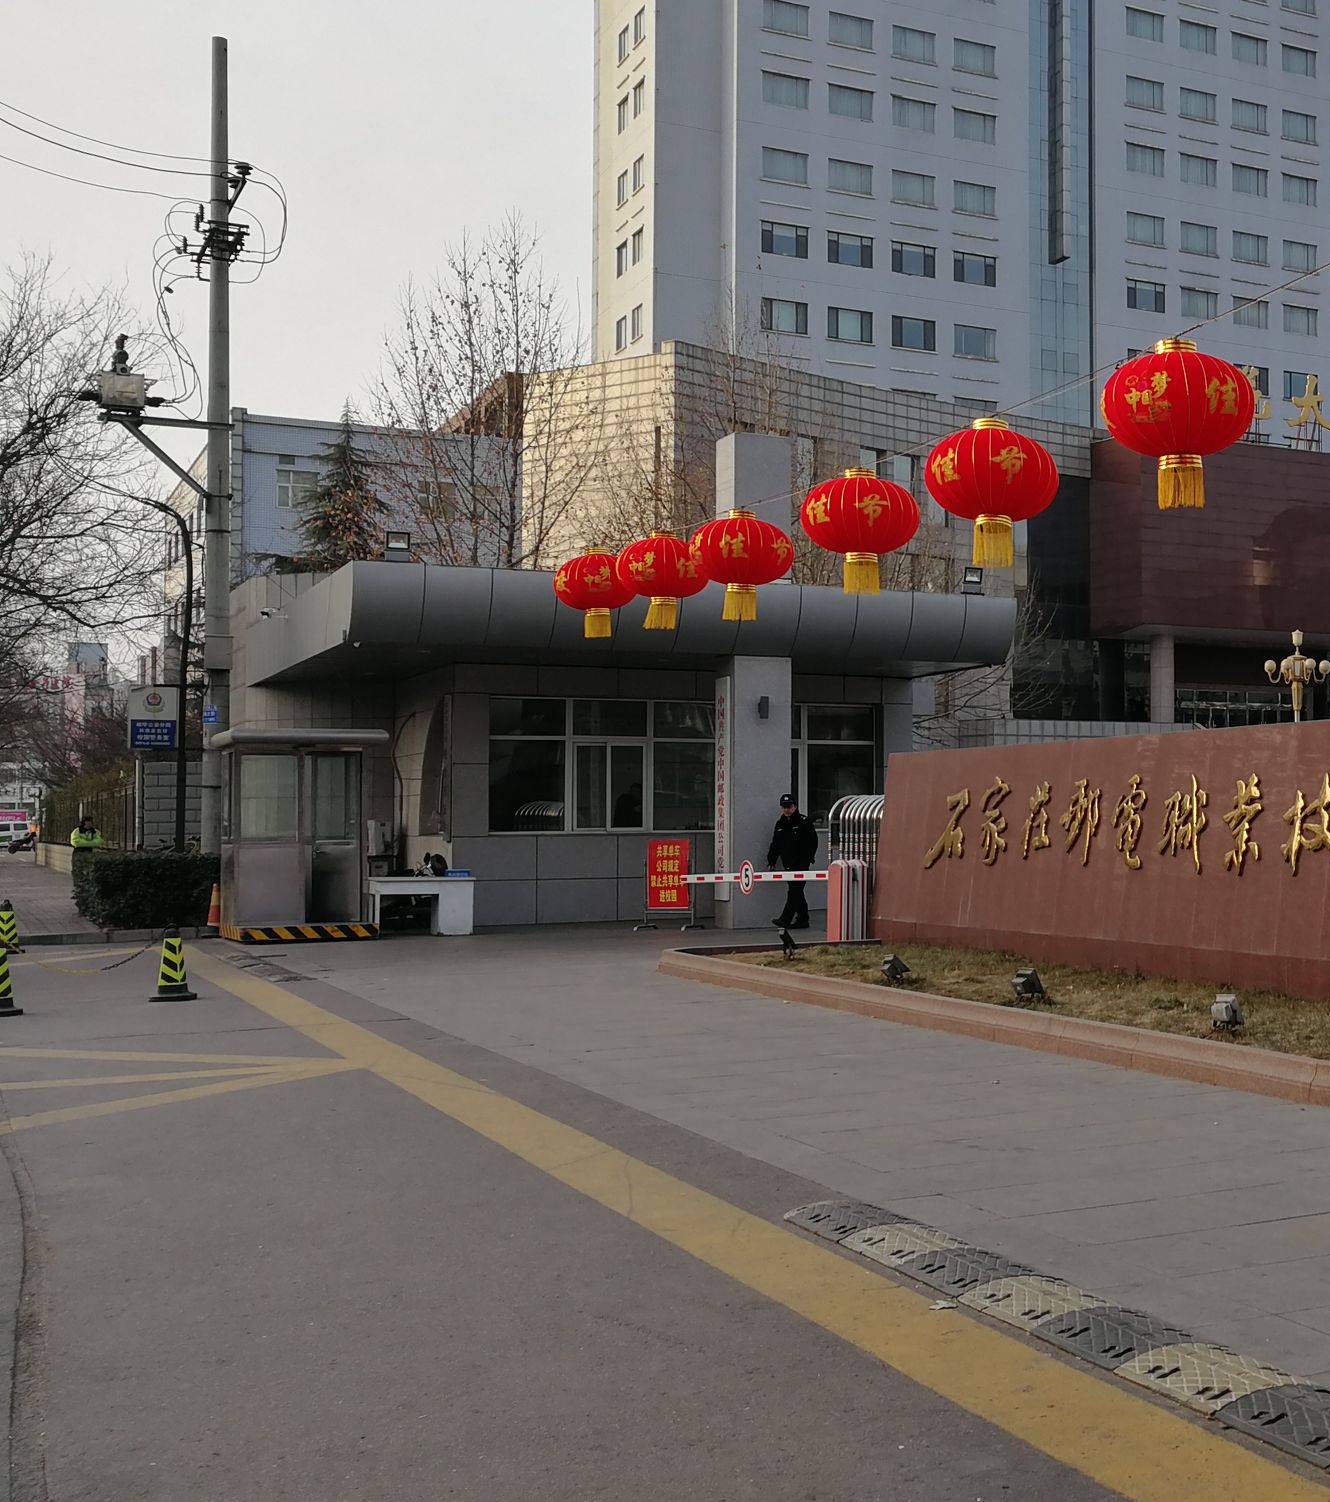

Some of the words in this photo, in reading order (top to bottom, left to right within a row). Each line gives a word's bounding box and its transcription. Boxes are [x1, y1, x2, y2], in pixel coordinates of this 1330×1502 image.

[1206, 374, 1240, 416] 佳
[717, 695, 726, 874] 中国共产党中国邮政集团公司党
[656, 845, 681, 858] 共享单车
[656, 860, 680, 873] 公司规定
[744, 867, 750, 888] 5
